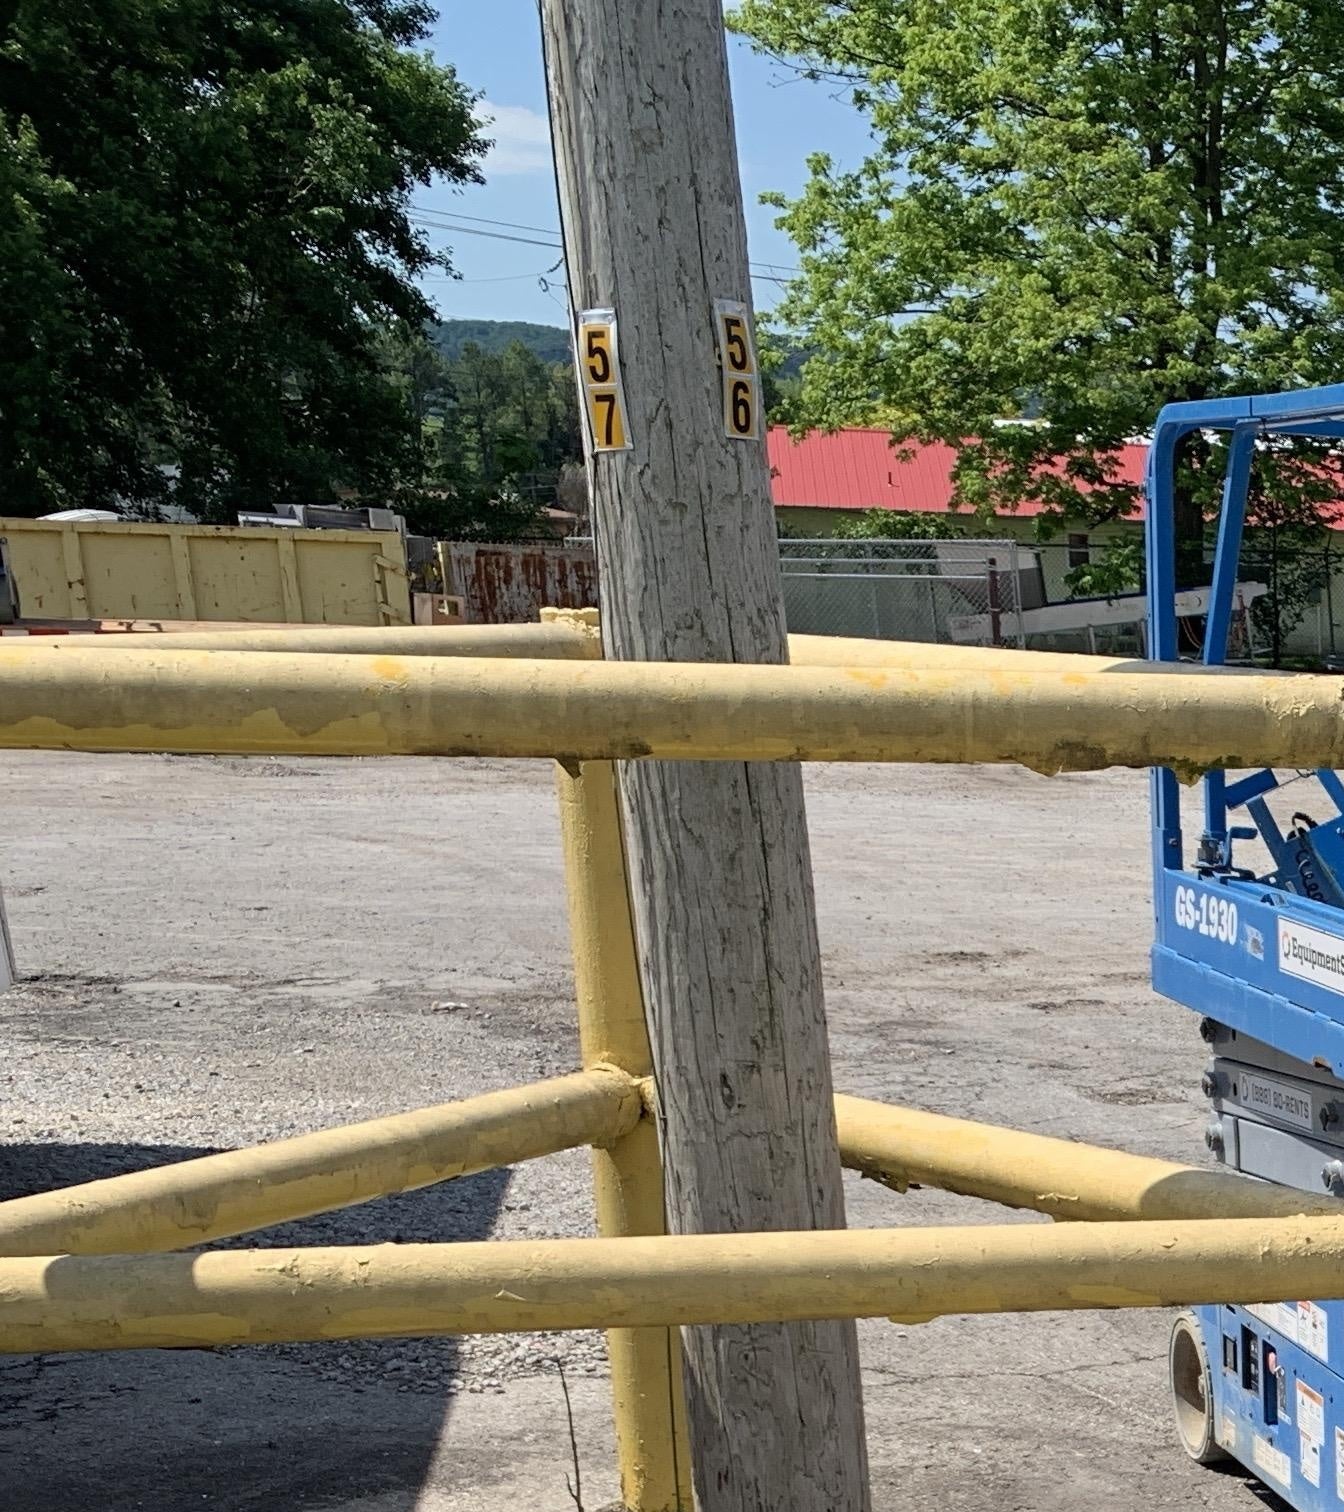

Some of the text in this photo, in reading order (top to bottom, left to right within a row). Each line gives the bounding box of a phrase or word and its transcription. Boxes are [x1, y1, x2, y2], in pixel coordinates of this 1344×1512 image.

[587, 331, 616, 445] 57
[724, 318, 751, 433] 56
[1175, 884, 1238, 946] GS-1930
